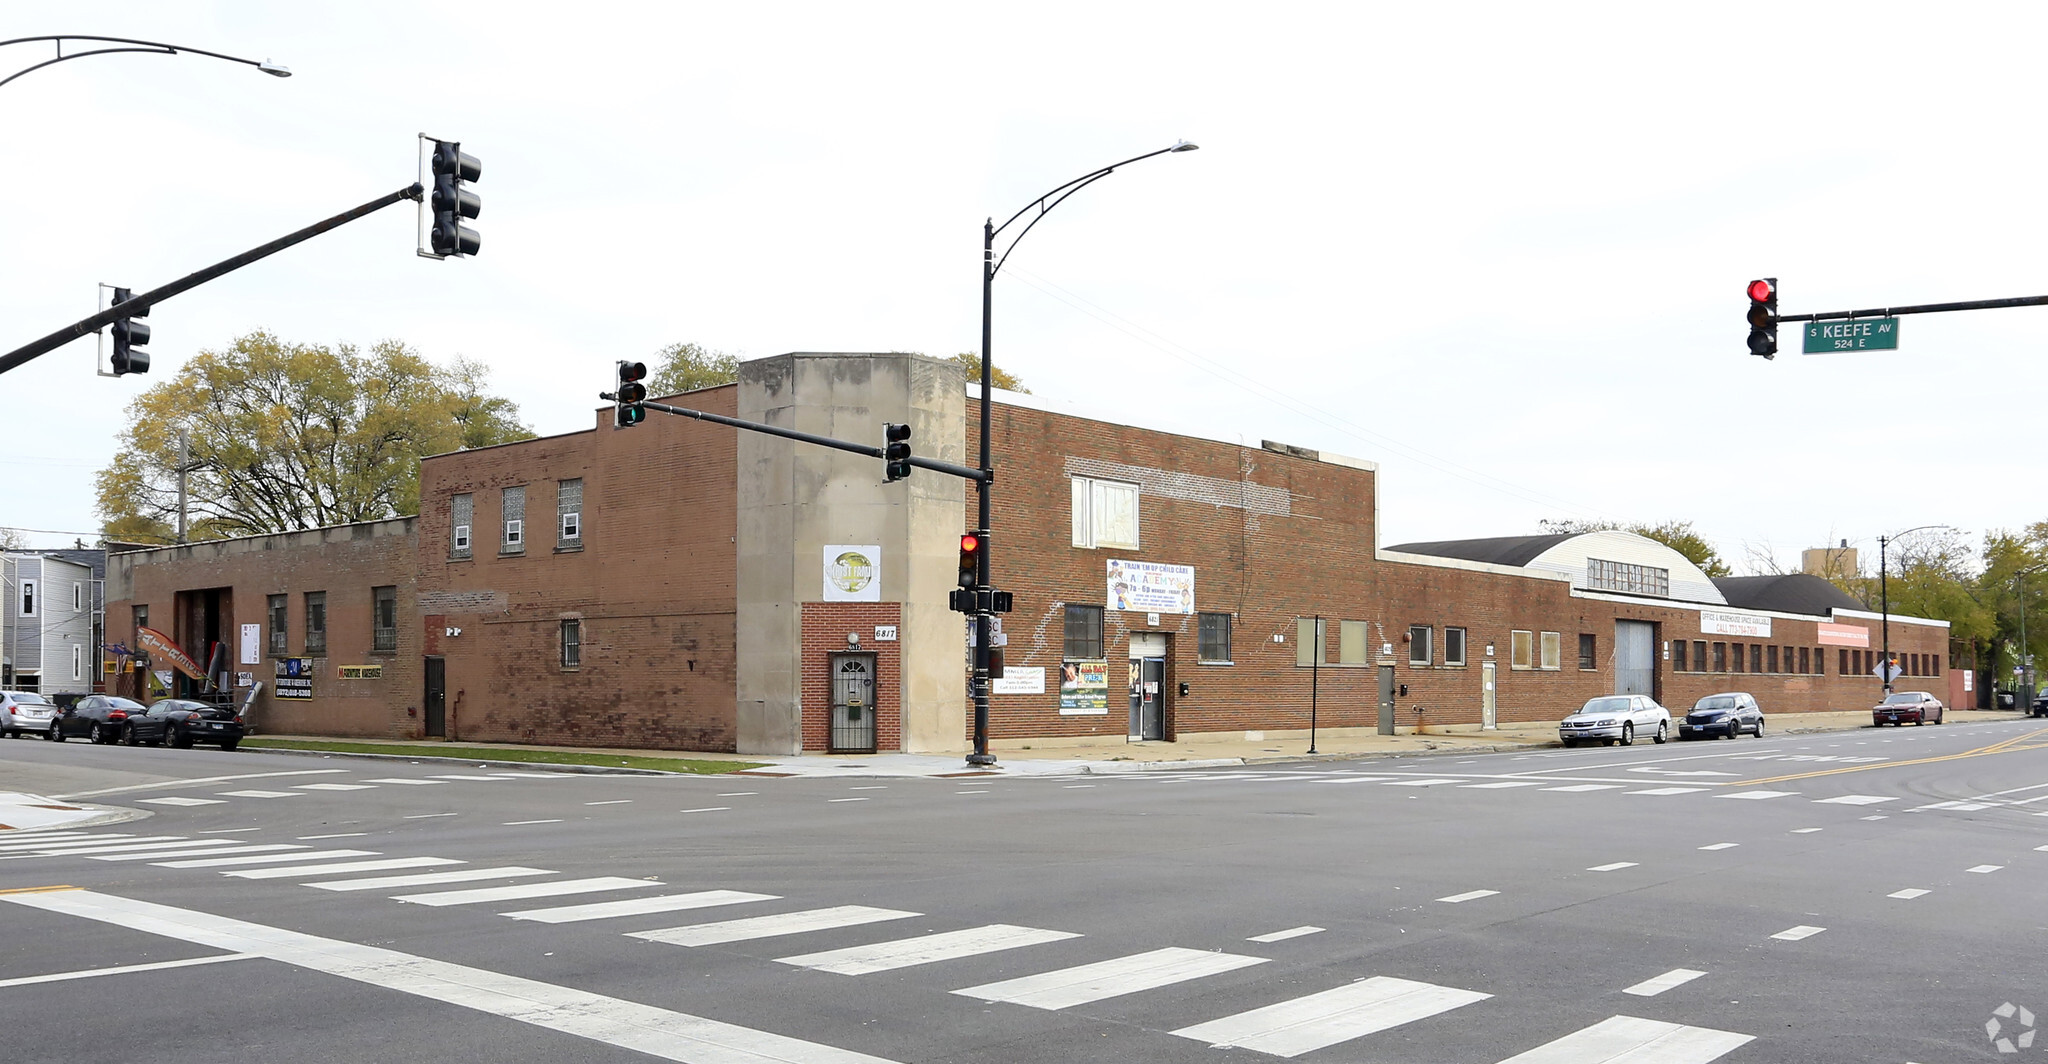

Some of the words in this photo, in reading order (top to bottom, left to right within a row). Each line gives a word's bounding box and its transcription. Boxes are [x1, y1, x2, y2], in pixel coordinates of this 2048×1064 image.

[1810, 328, 1817, 337] S
[1823, 323, 1872, 338] KEEFE
[1878, 323, 1892, 334] AV
[1834, 339, 1853, 349] 524
[1858, 338, 1866, 347] E
[1124, 562, 1140, 570] TRAIN
[1159, 565, 1174, 573] CHILD
[1175, 567, 1189, 575] CARE
[1130, 574, 1175, 586] ACADEMY
[1702, 613, 1715, 621] OFFICE
[1719, 614, 1740, 623] WAREHOUSE
[1741, 616, 1752, 624] SPACE
[1752, 617, 1770, 626] AVAILABLE
[1716, 623, 1728, 633] CALL
[876, 630, 895, 638] 6817
[1093, 664, 1107, 673] DAY
